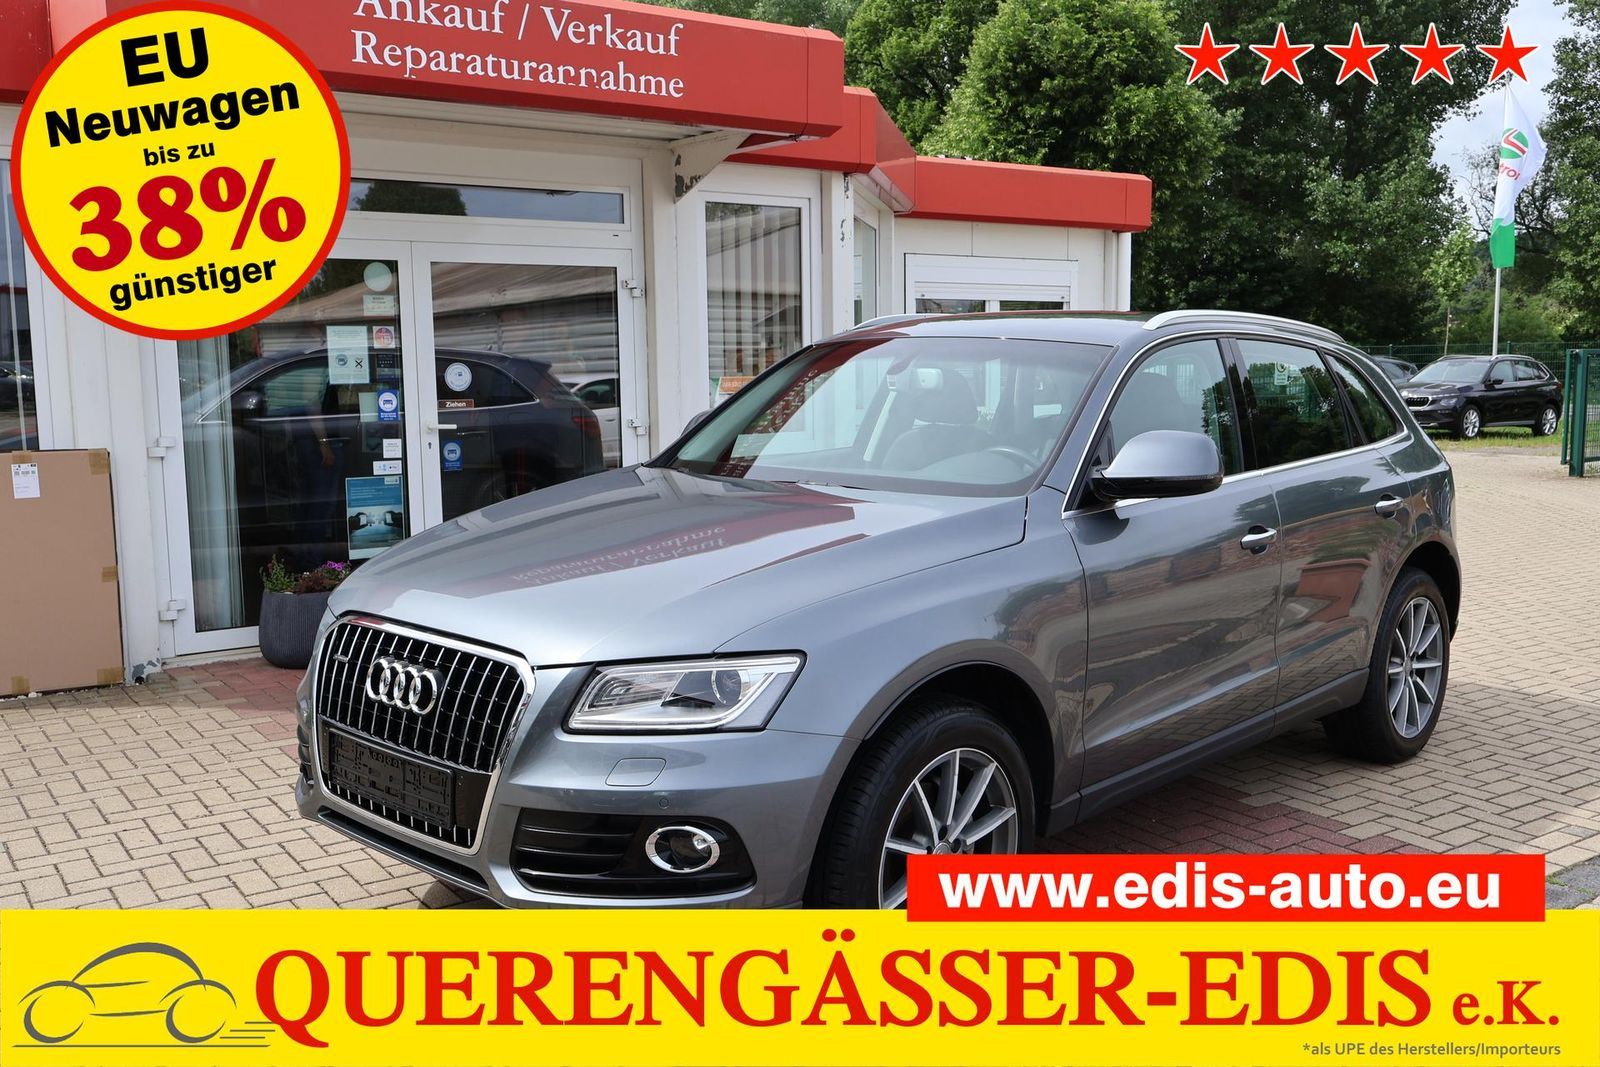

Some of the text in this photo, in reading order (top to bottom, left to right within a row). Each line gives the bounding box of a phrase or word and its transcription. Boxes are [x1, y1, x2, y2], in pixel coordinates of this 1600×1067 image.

[517, 4, 530, 41] /
[540, 6, 685, 57] Verkauf
[351, 29, 685, 98] Reparaturannahme
